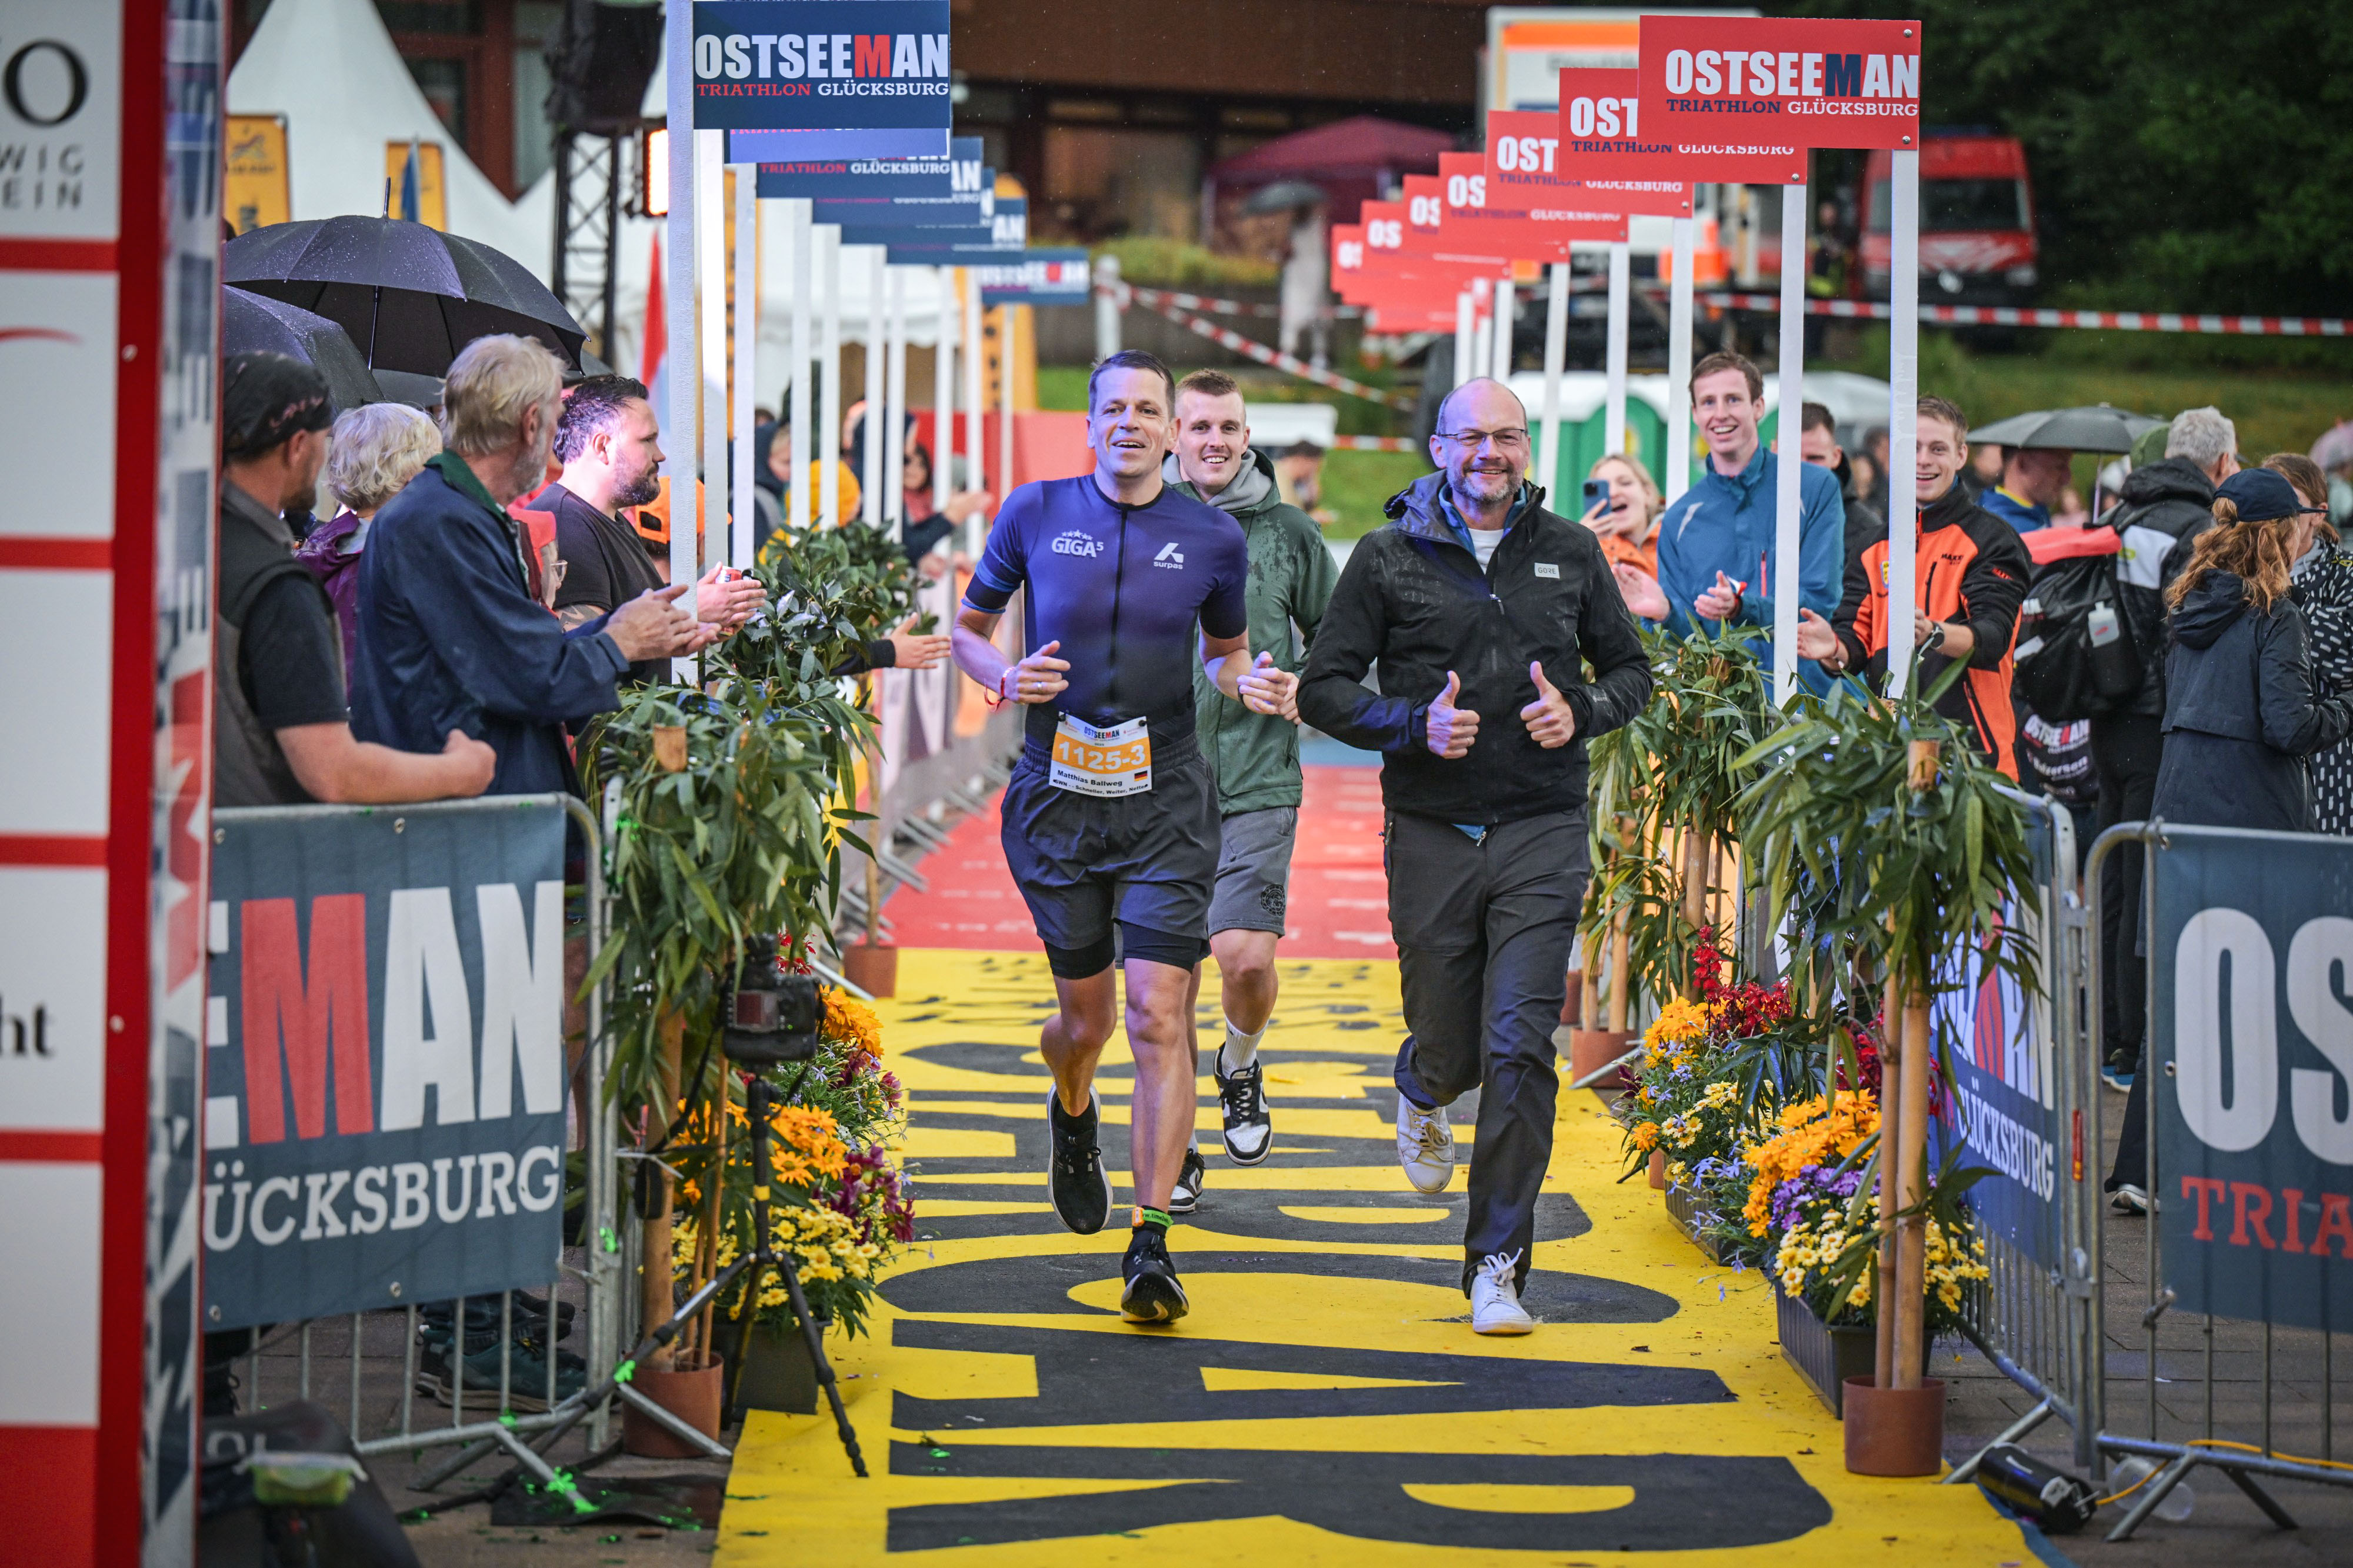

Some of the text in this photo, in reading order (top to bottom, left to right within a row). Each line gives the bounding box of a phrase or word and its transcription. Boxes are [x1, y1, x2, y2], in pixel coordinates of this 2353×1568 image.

[695, 34, 948, 79] OSTSEEMAN
[1665, 49, 1919, 98] OSTSEEMAN
[696, 79, 949, 96] TRIATHLON GLÜCKSBURG
[1667, 98, 1918, 116] TRIATHLON GLÜCKSBURG
[1571, 141, 1672, 152] TRIATHLON
[760, 159, 950, 174] TRIATHLON GLÜCKSBURG
[1154, 561, 1183, 569] surpas
[1084, 726, 1120, 739] OSTSEEMAN
[1059, 742, 1146, 770] 1125-3
[1058, 770, 1088, 783] Matthias
[1075, 785, 1105, 795] Schneller,
[2175, 907, 2353, 1166] OS
[2181, 1176, 2353, 1260] TRIA
